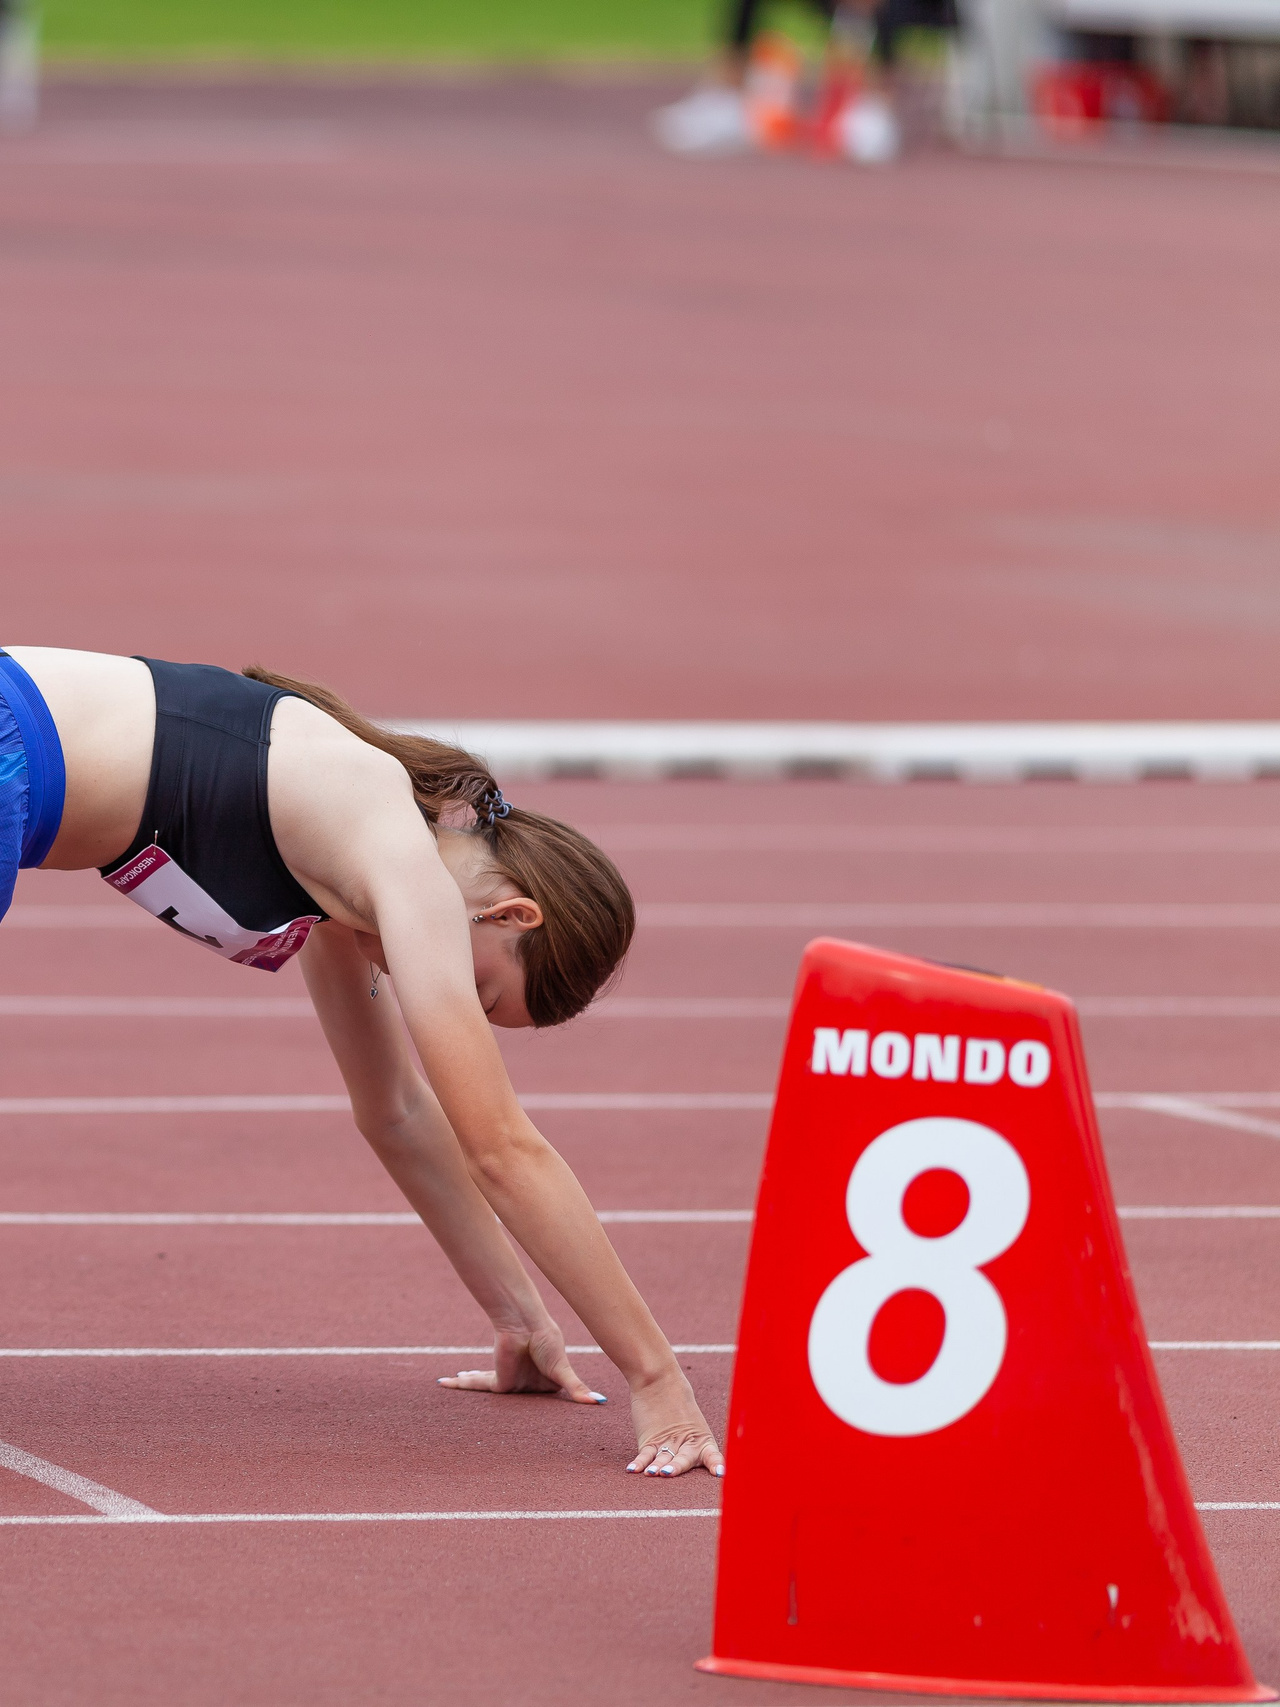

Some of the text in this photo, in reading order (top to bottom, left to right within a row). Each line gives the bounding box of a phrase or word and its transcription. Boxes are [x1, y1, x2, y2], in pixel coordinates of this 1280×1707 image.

[113, 857, 156, 887] ЧЕБОКСАРЫ
[812, 1028, 1050, 1086] MONDO
[808, 1117, 1029, 1436] 8
